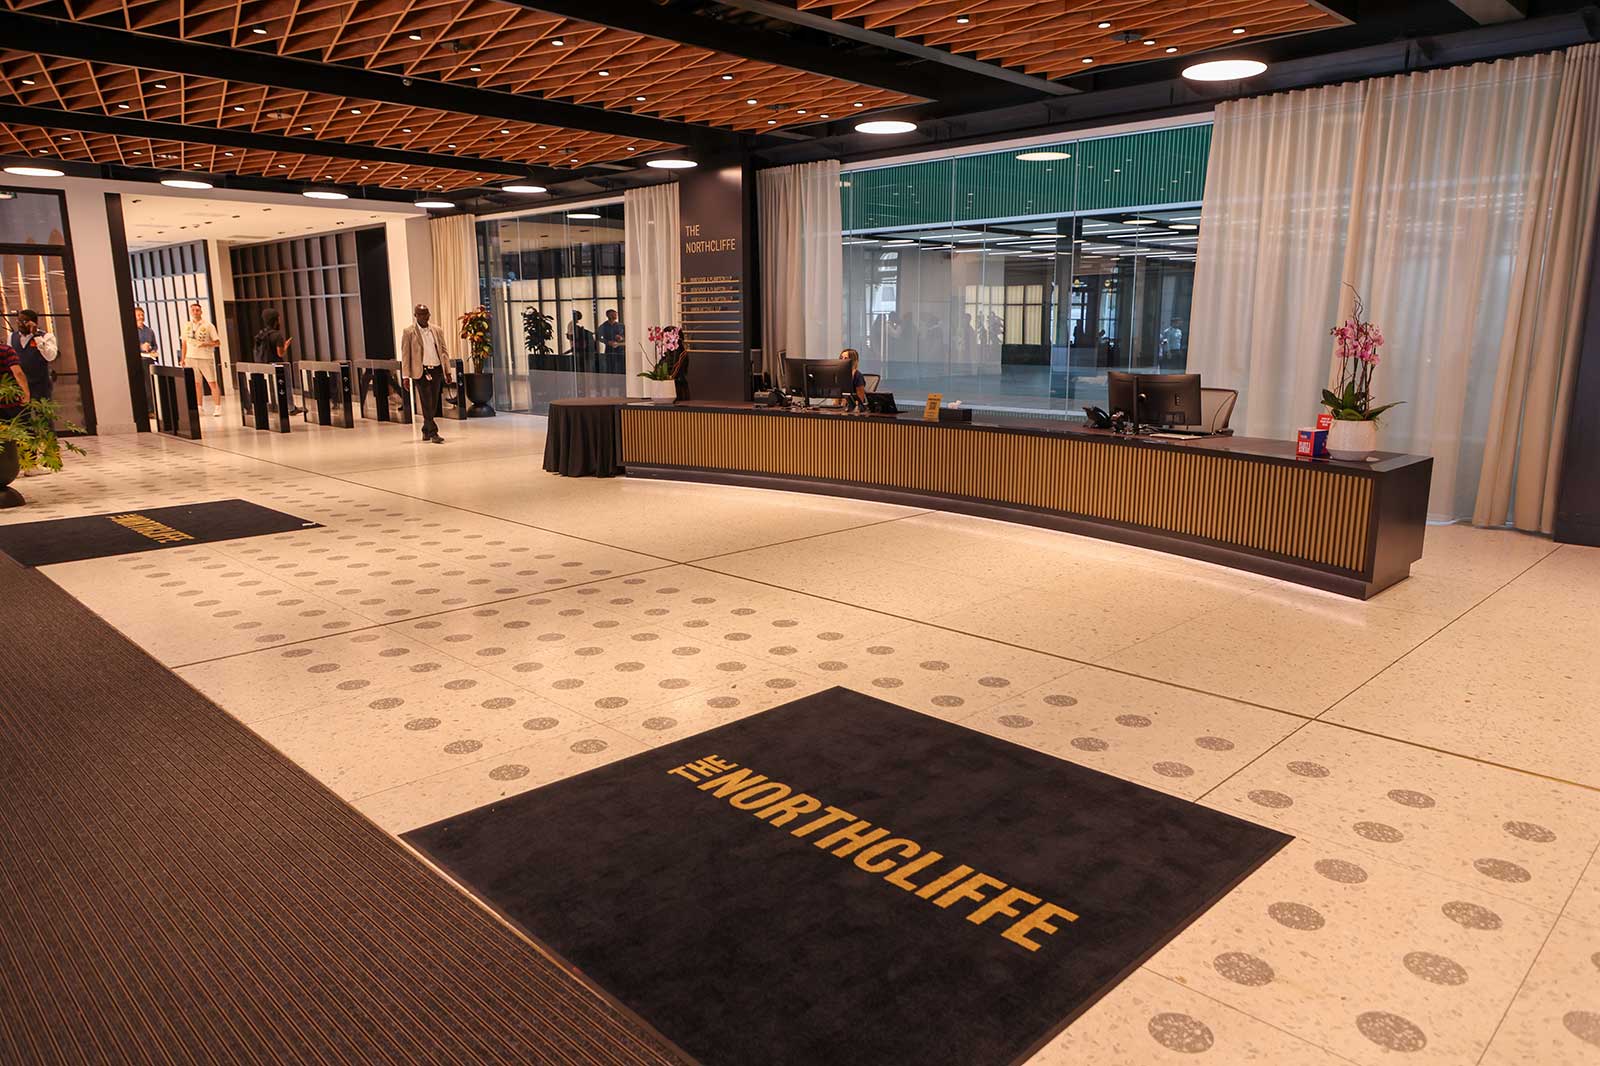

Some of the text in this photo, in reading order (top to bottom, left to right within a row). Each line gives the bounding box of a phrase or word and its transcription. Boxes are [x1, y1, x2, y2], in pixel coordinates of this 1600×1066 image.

[685, 224, 700, 237] THE
[685, 238, 736, 254] NORTHCLIFFE
[667, 754, 739, 783] THE
[697, 767, 1080, 952] NORTHCLIFFE
